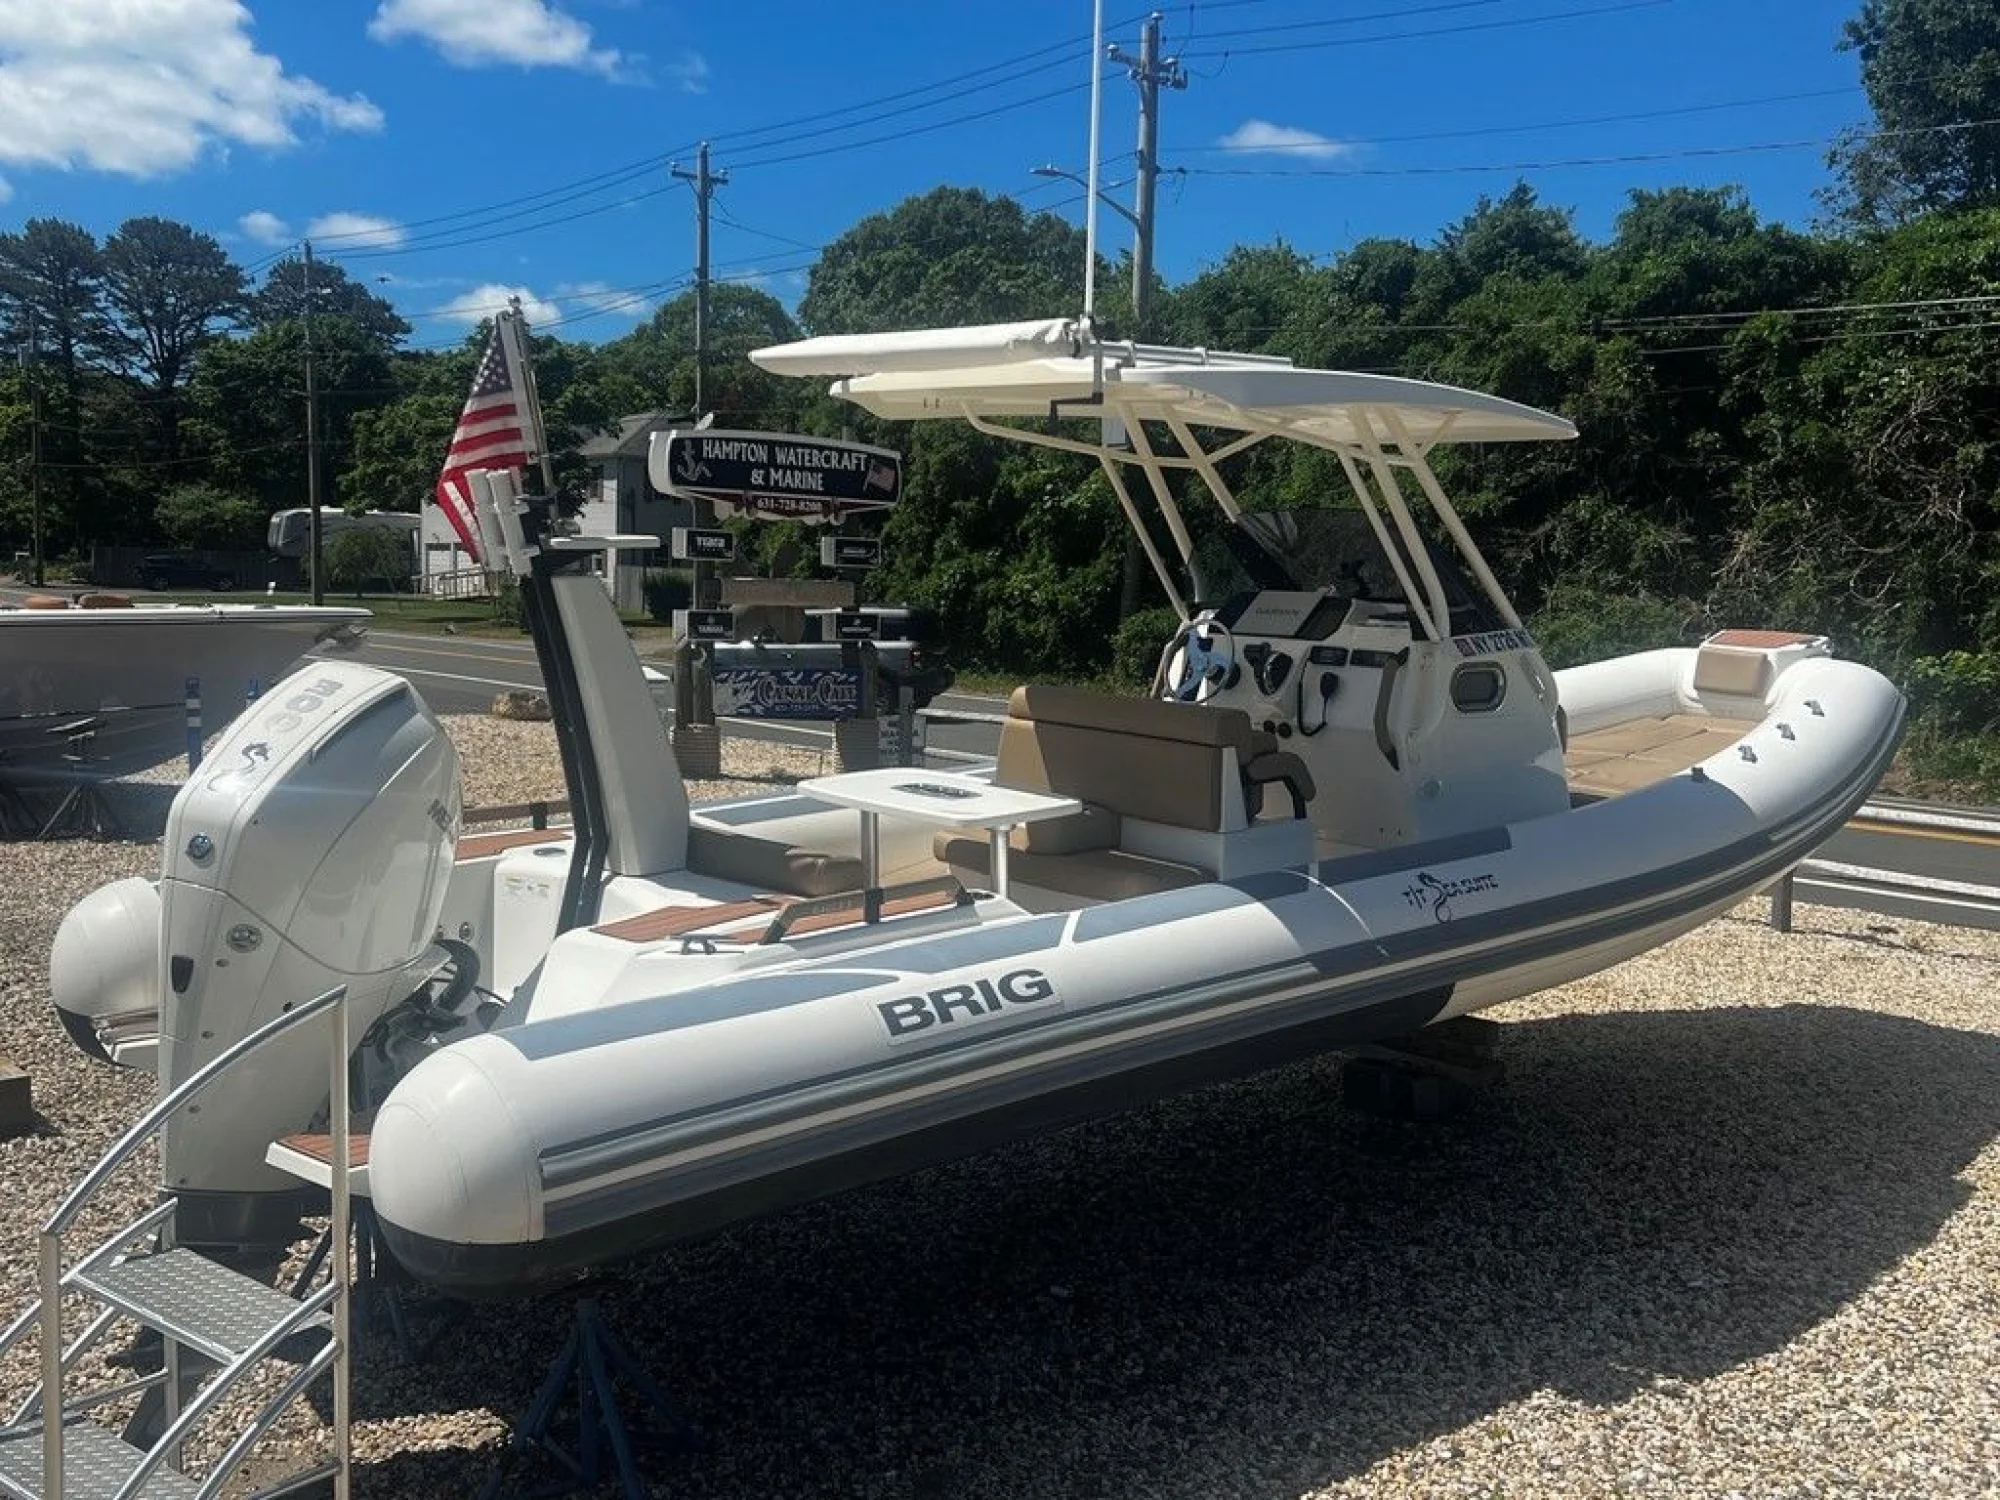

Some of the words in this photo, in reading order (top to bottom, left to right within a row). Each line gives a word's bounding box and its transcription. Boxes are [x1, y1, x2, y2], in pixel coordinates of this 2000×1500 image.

[702, 439, 768, 464] HAMPTON
[774, 446, 867, 472] WATERCRAFT
[750, 468, 765, 486] &
[769, 468, 824, 491] MARINE
[876, 968, 1054, 1037] BRIG
